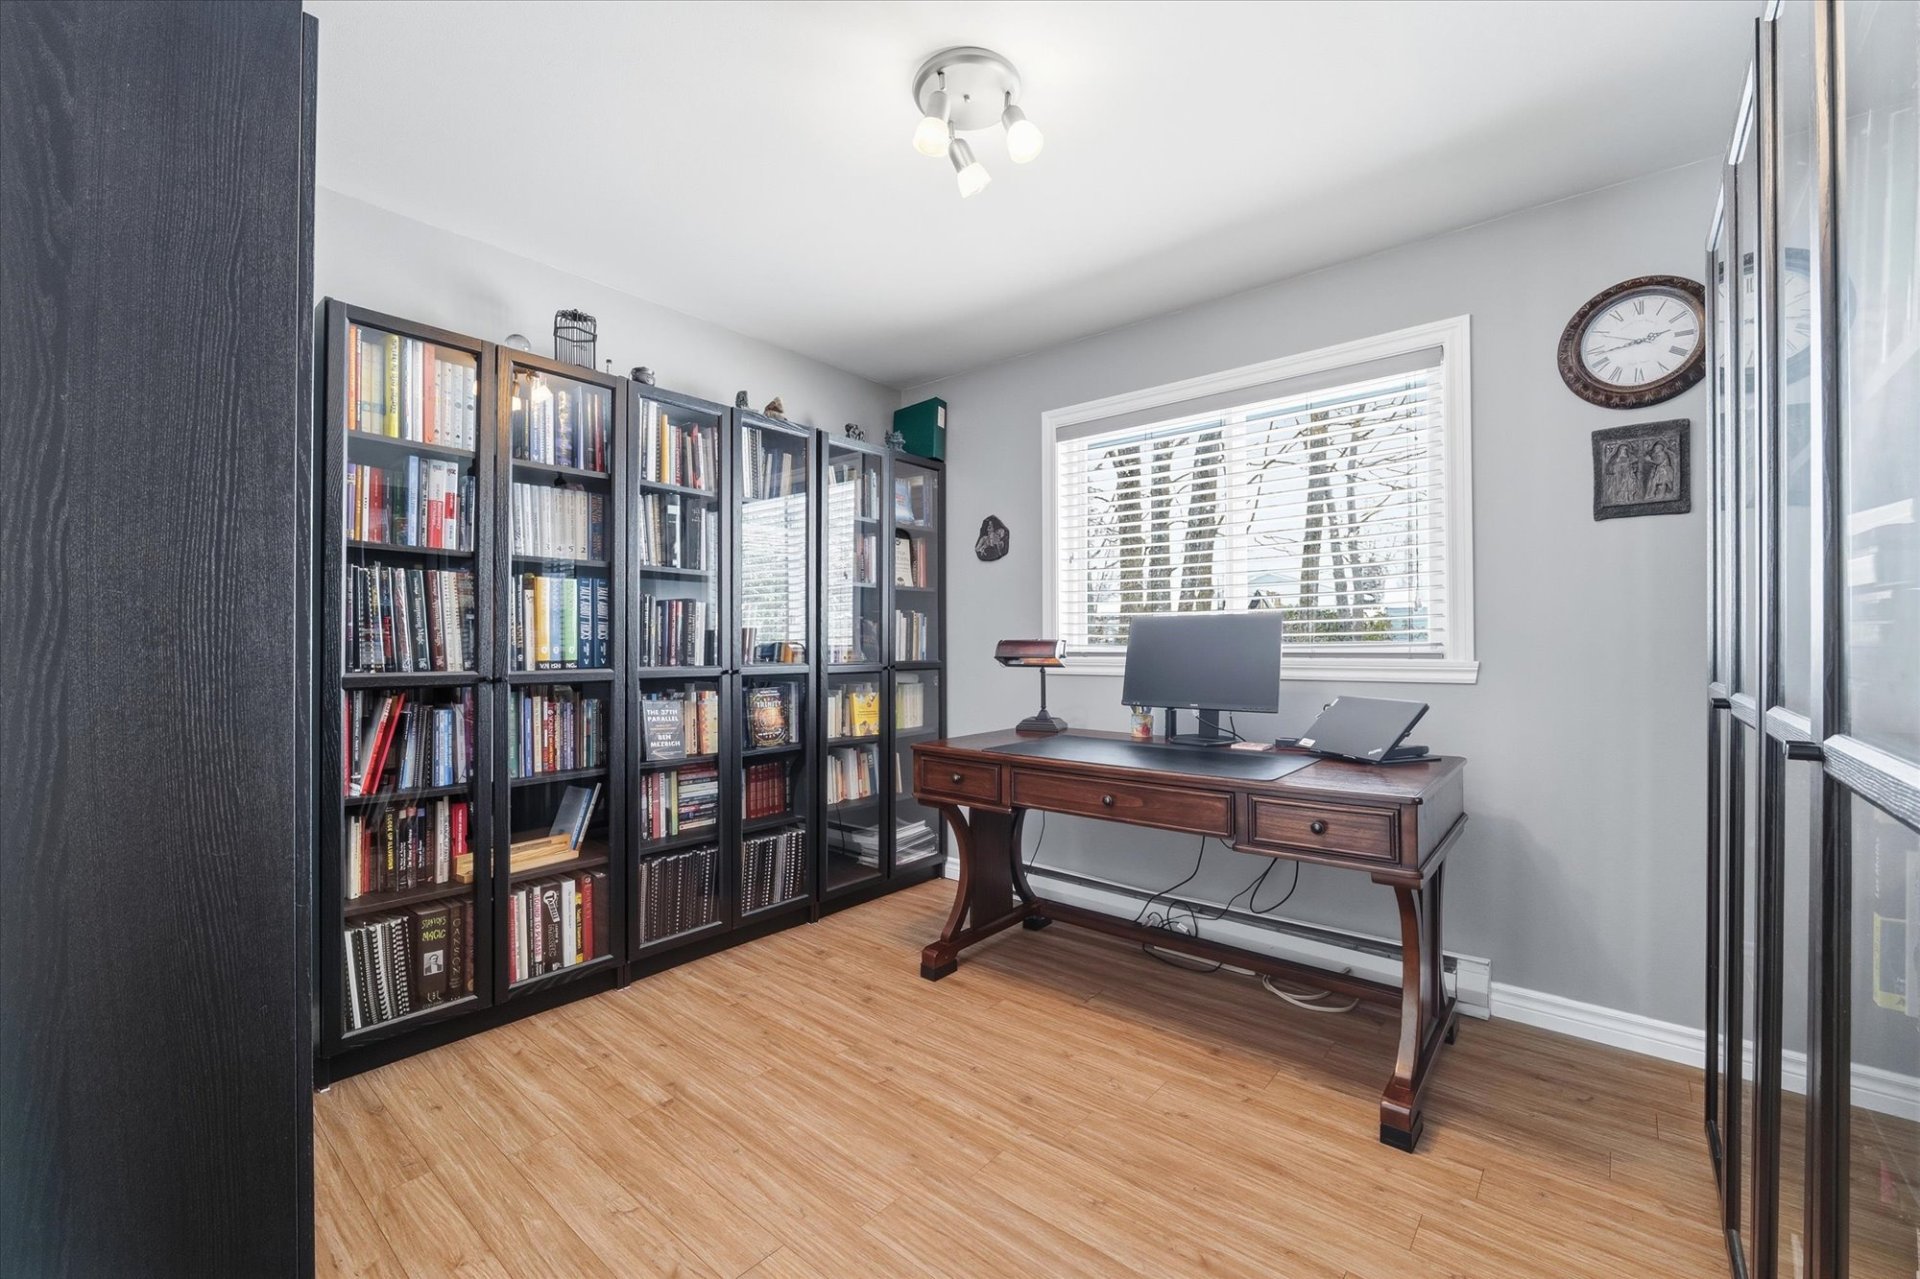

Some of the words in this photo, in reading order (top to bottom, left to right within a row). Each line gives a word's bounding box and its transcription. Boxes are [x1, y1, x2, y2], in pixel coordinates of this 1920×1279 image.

[580, 586, 592, 600] TALK
[597, 586, 609, 600] TALK
[580, 600, 592, 619] ABOUT
[597, 600, 609, 620] ABOUT
[580, 621, 592, 640] TRICKS
[597, 621, 609, 640] TRICKS
[422, 929, 447, 942] MAGIC
